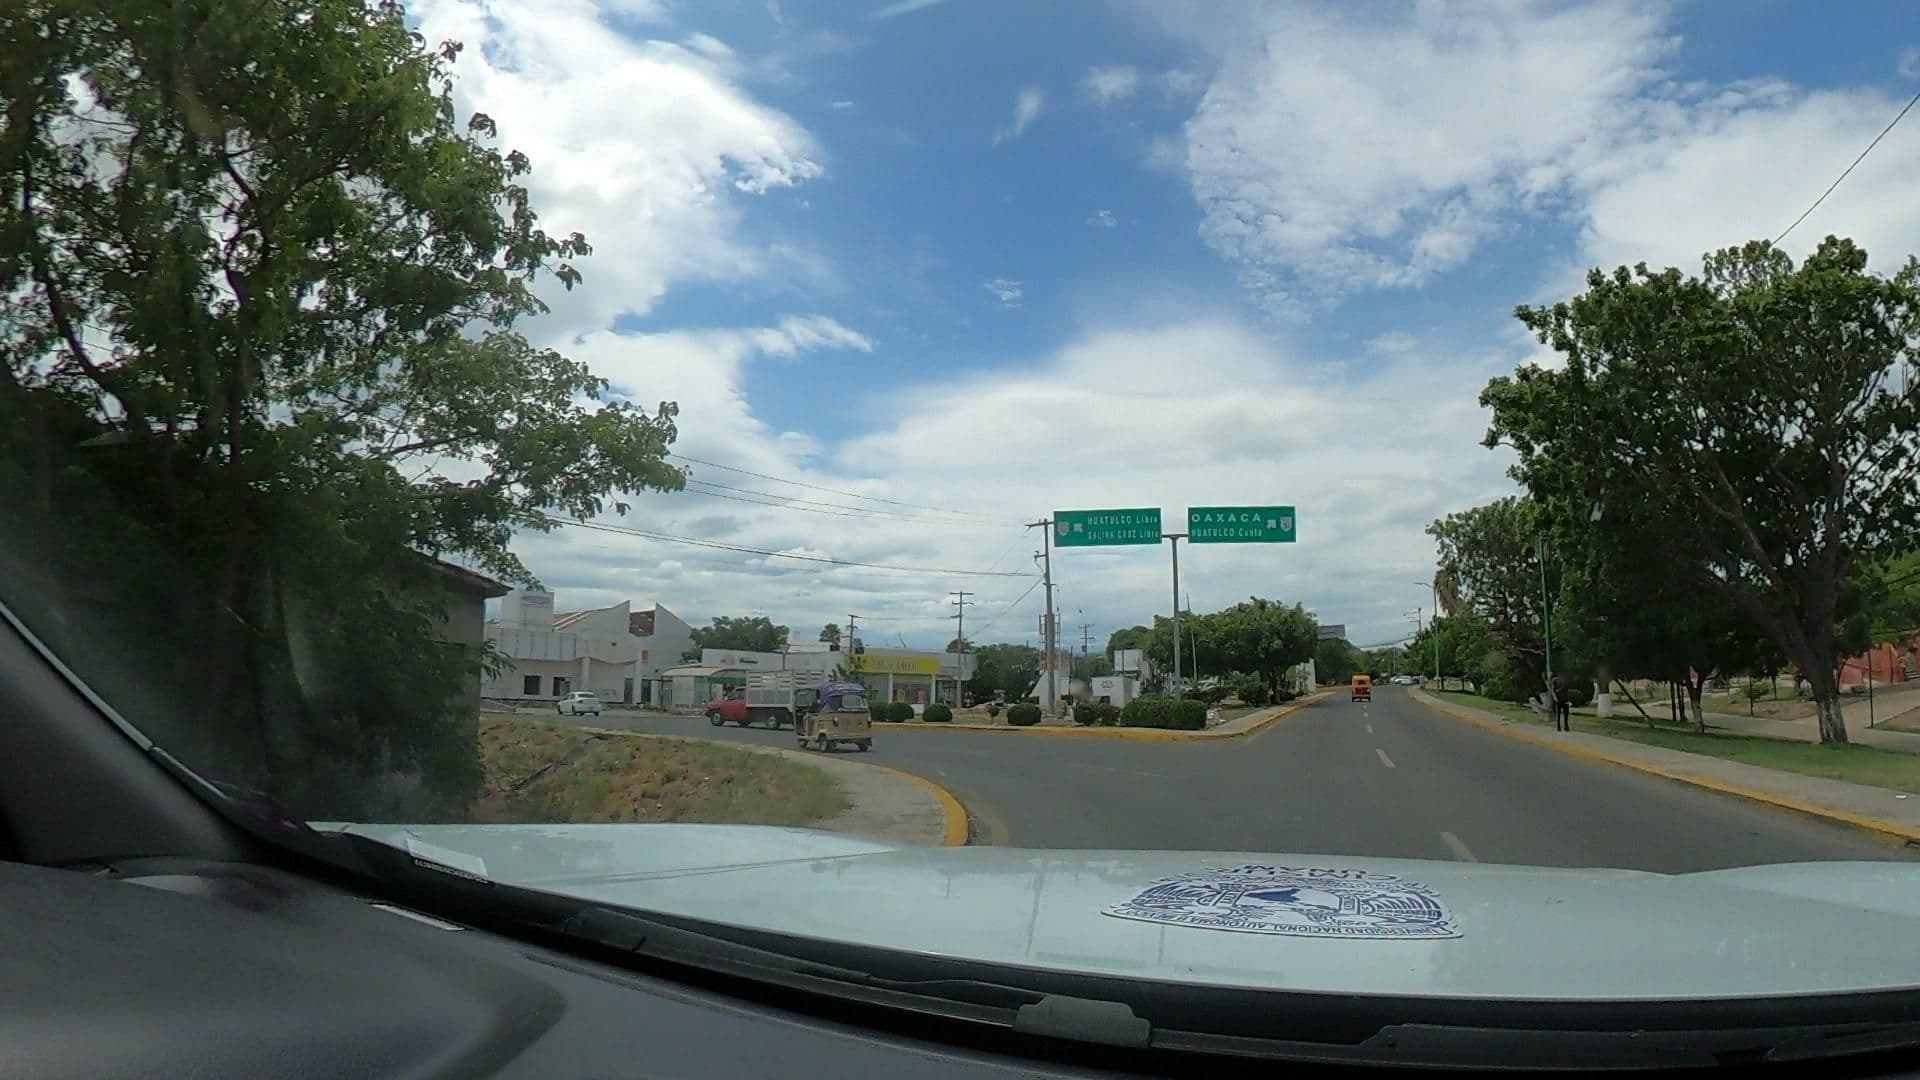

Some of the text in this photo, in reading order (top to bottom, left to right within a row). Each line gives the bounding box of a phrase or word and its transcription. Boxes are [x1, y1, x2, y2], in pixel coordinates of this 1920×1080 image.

[1191, 513, 1262, 523] OAXACA
[1117, 529, 1137, 539] CRUZ
[1191, 528, 1235, 537] HUATULCO
[1274, 924, 1345, 933] NACIONAL
